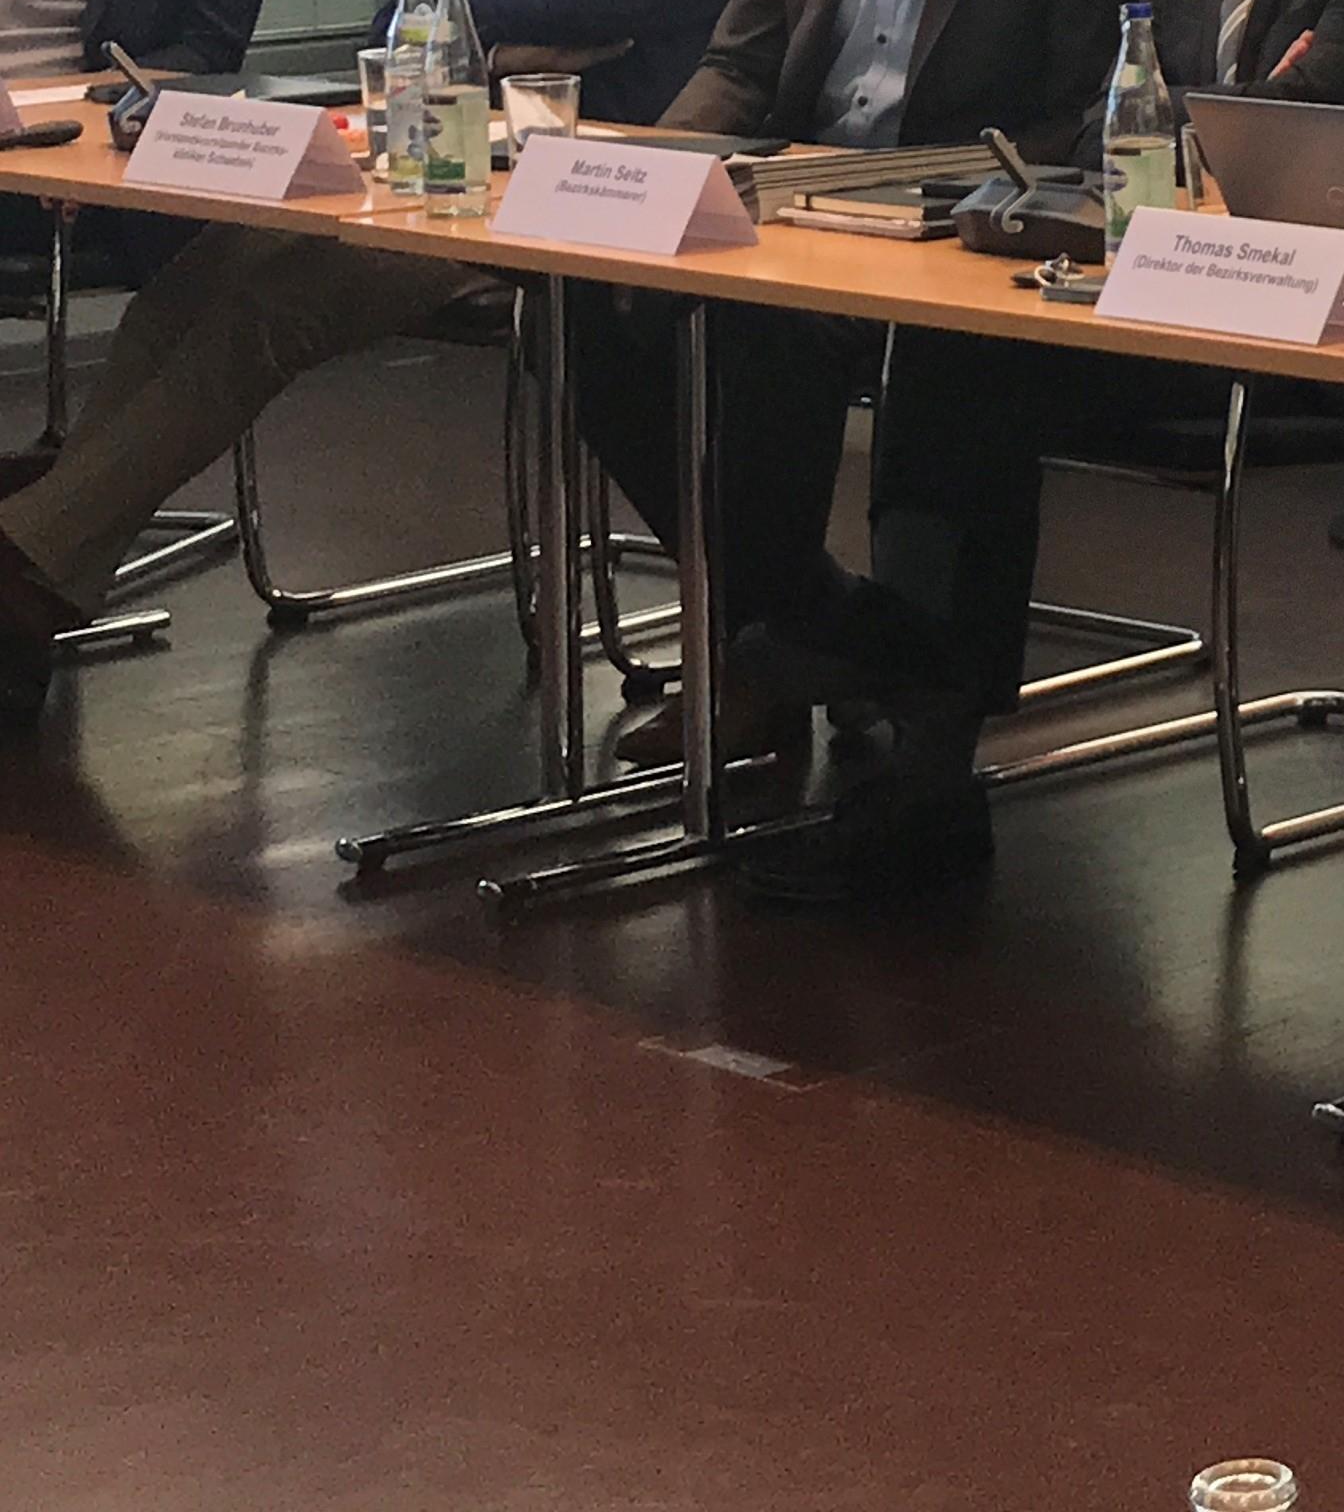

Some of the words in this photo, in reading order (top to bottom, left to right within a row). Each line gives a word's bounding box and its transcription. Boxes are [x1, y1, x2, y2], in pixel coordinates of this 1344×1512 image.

[571, 159, 612, 180] Martin
[614, 164, 648, 184] Seitz
[1173, 234, 1234, 259] Thomas
[1236, 242, 1297, 266] Smekal
[1132, 254, 1182, 273] (Direktor
[1185, 262, 1204, 276] der
[1206, 263, 1319, 294] Bezirksverwaltung)
